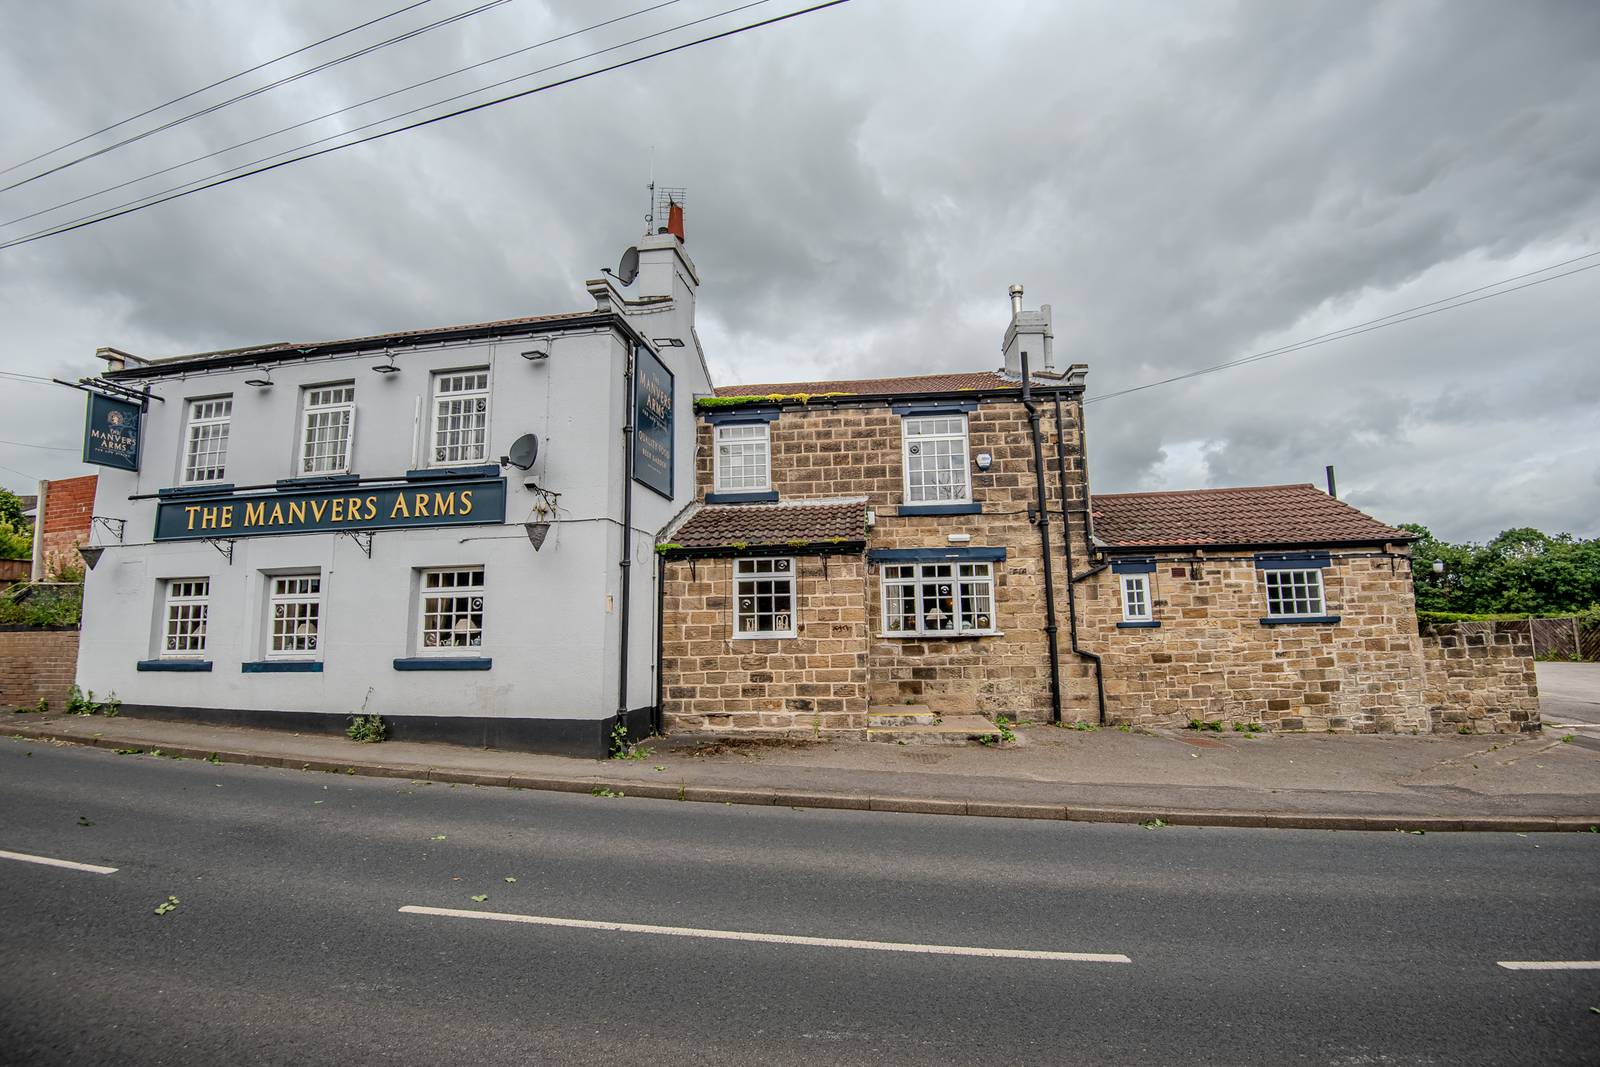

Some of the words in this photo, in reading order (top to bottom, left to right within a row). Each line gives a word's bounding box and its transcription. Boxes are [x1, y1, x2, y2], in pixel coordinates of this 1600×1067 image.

[640, 368, 671, 409] MANVERS
[646, 394, 664, 419] ARMS
[91, 429, 137, 446] MANVERS
[101, 439, 127, 451] ARMS
[185, 505, 233, 530] THE
[243, 496, 377, 527] MANVERS
[390, 490, 473, 520] ARMS
